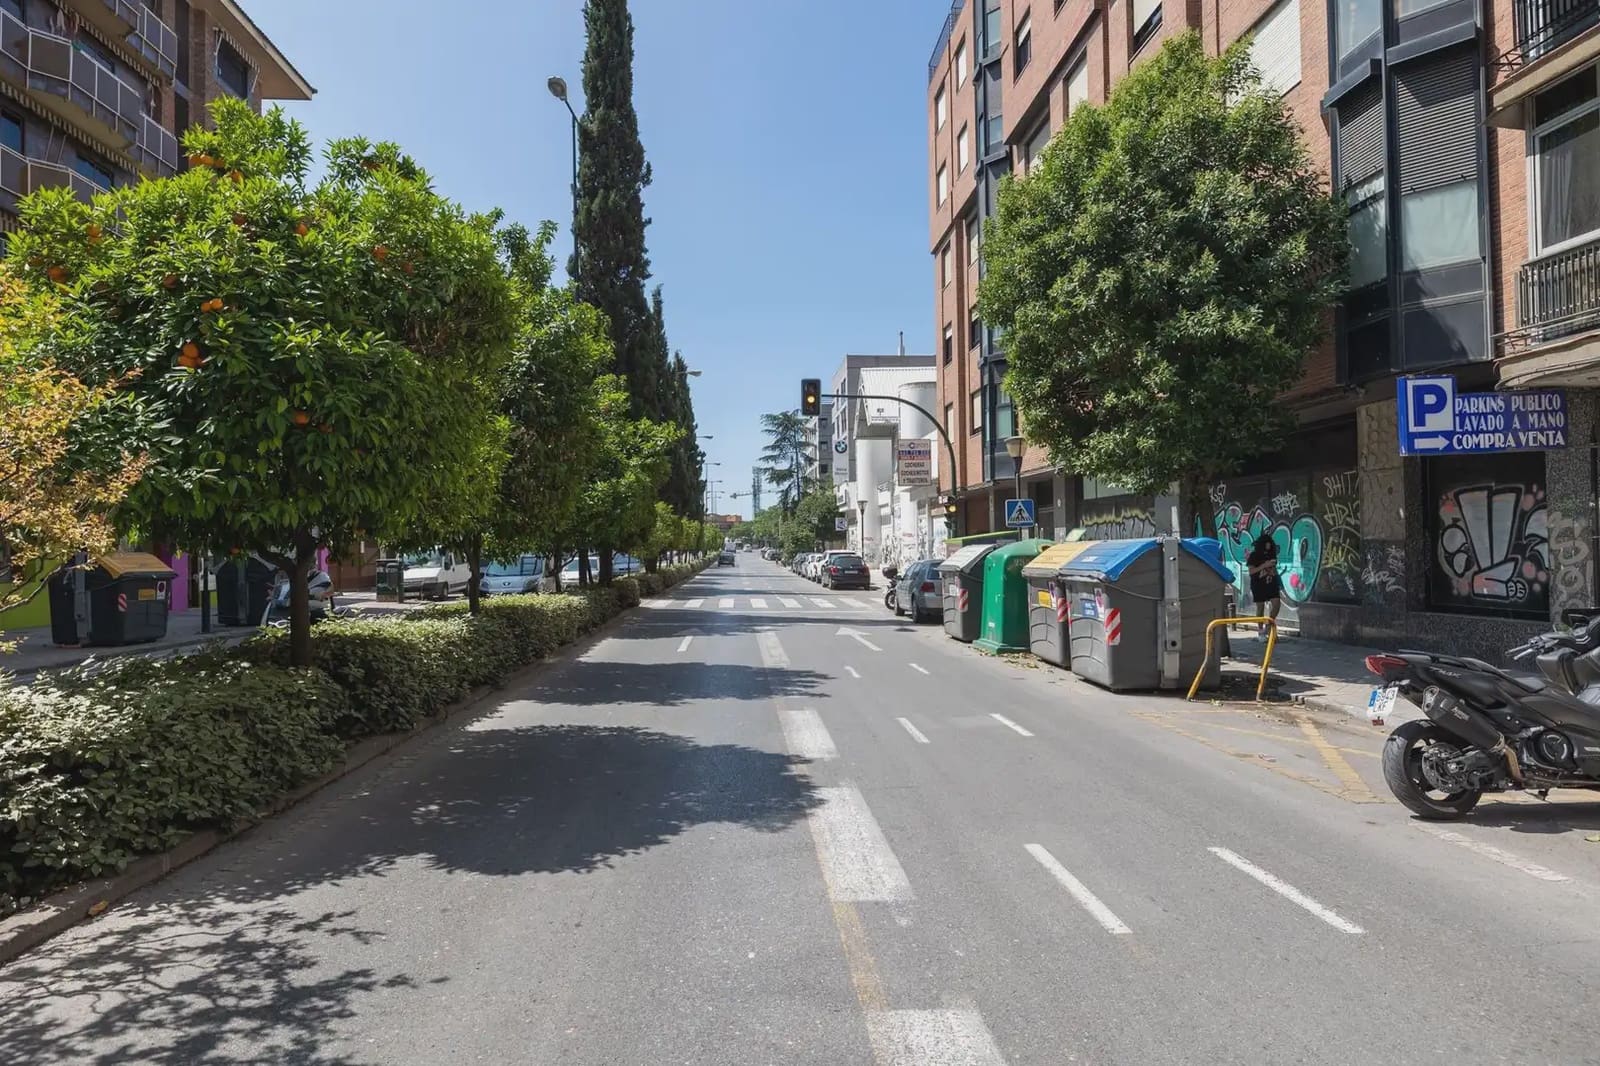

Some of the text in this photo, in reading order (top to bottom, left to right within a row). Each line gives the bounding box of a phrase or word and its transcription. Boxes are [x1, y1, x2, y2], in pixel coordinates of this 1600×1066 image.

[1413, 384, 1447, 427] P
[1511, 393, 1561, 411] PUBLICO
[1455, 412, 1565, 432] LAVADO A MANO
[1452, 431, 1565, 449] COMPRA VENTA
